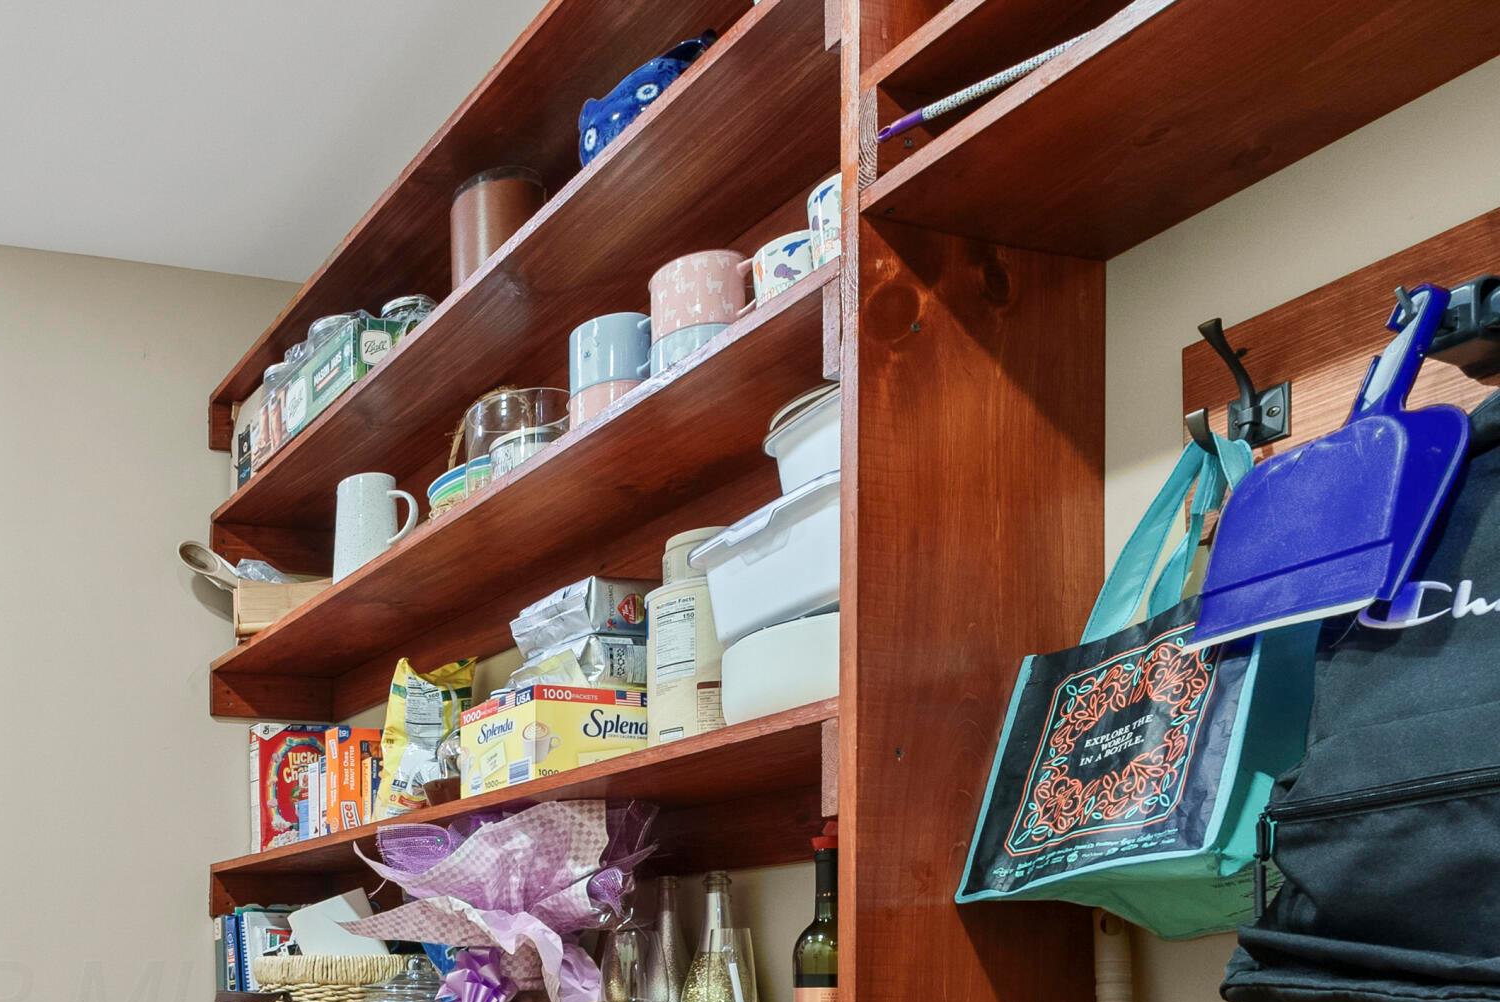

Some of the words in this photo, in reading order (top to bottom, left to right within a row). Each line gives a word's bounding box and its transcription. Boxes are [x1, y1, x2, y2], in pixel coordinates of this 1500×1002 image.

[364, 339, 387, 360] Ball
[678, 595, 695, 605] Facts
[516, 692, 531, 706] USA
[542, 688, 572, 701] 1000
[462, 709, 482, 725] 1000
[582, 708, 648, 739] Splend
[477, 718, 514, 745] Splenda
[1084, 724, 1130, 748] EXPLORE
[1132, 713, 1154, 729] THE
[1101, 732, 1134, 750] WORLD
[1079, 756, 1096, 766] IN
[1095, 753, 1104, 763] A
[1103, 738, 1145, 759] BOTTLE.
[344, 804, 356, 828] nce
